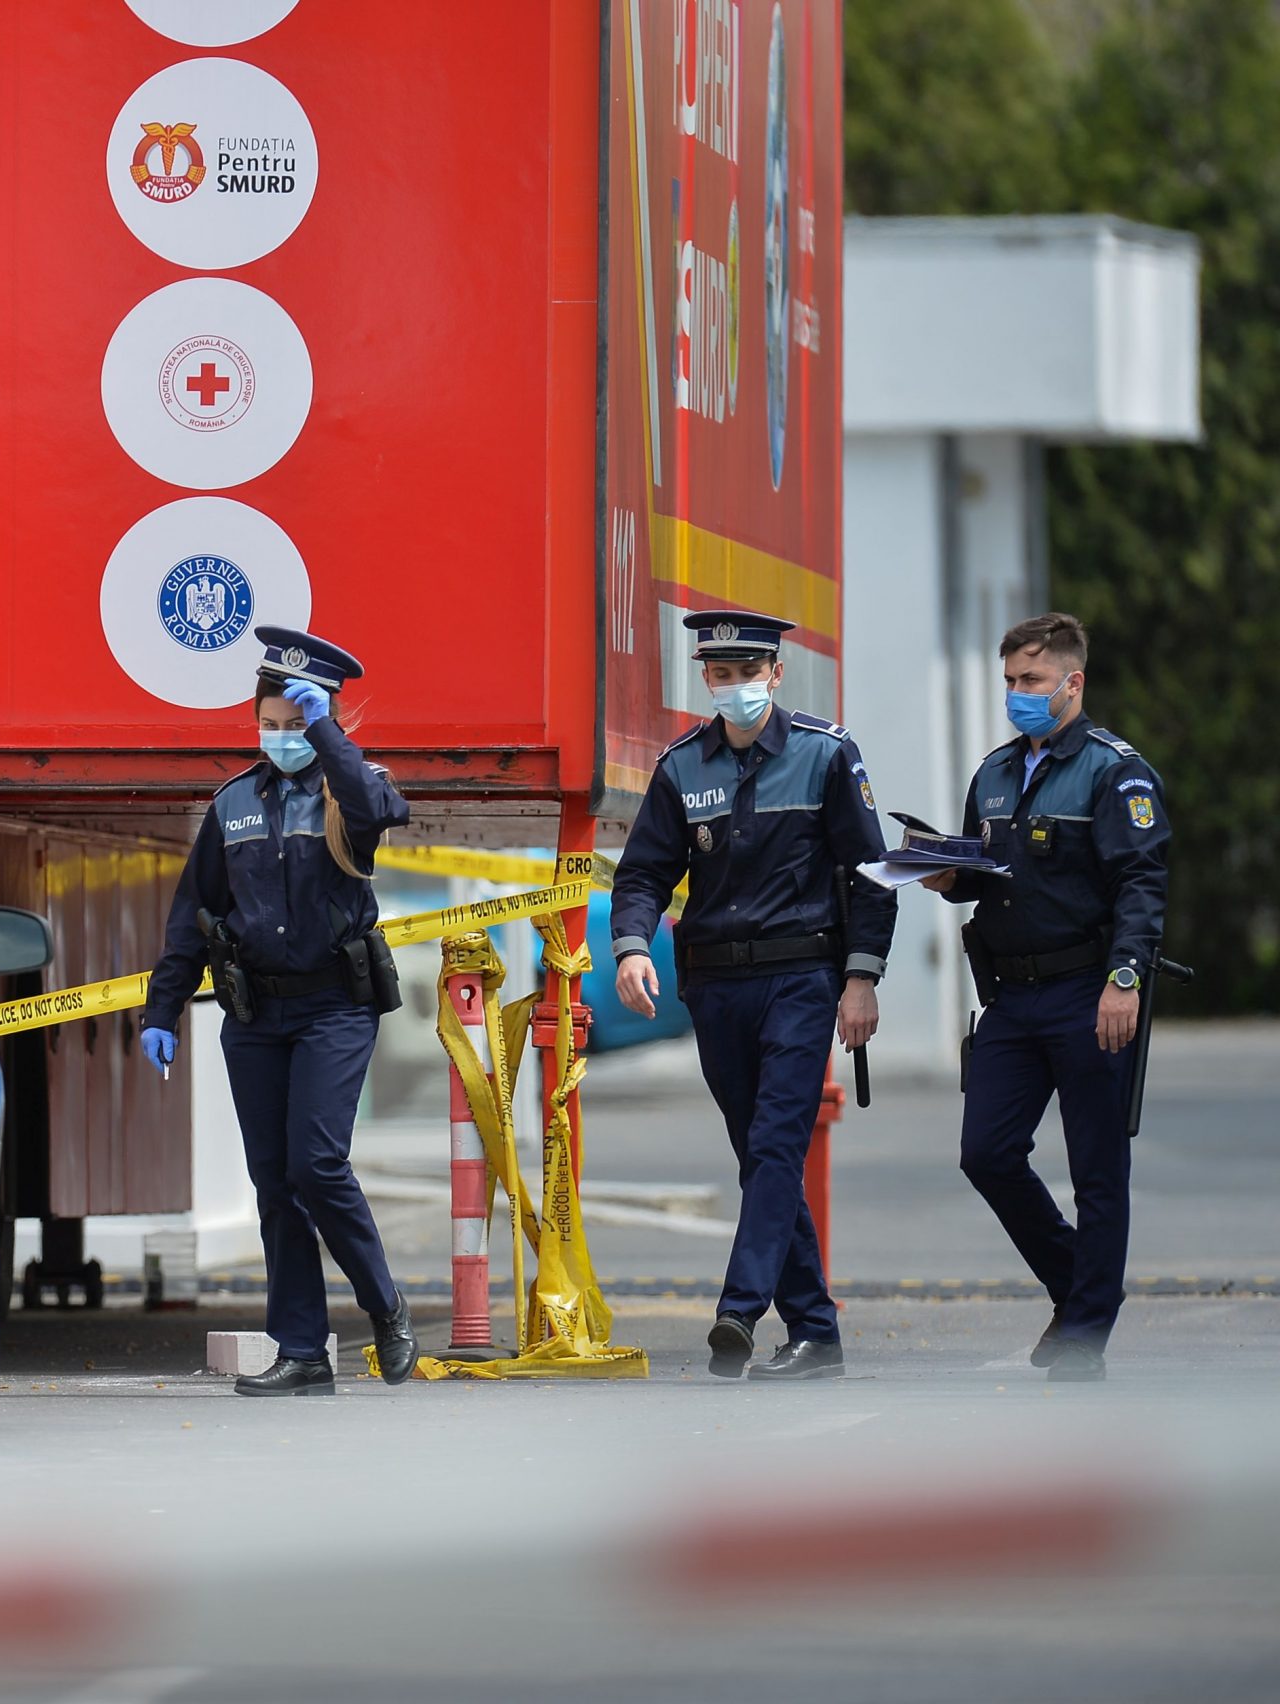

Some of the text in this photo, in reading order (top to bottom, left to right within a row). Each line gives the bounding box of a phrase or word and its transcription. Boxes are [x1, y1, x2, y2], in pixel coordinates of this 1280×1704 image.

[218, 137, 295, 154] FUNDAȚIA
[218, 153, 296, 172] Pentru
[142, 181, 192, 200] SMURD
[217, 175, 295, 193] SMURD
[163, 356, 177, 404] SOCIETATEA
[222, 343, 233, 352] DE
[233, 351, 251, 377] CRUCE
[166, 559, 245, 592] GUVERNUL
[164, 612, 248, 648] ROMÂNIEI
[566, 857, 592, 874] CRO
[506, 895, 520, 911] NU
[20, 1002, 33, 1020] DO
[34, 998, 52, 1017] NOT
[54, 991, 83, 1013] CROSS
[557, 1187, 572, 1242] PERICOL
